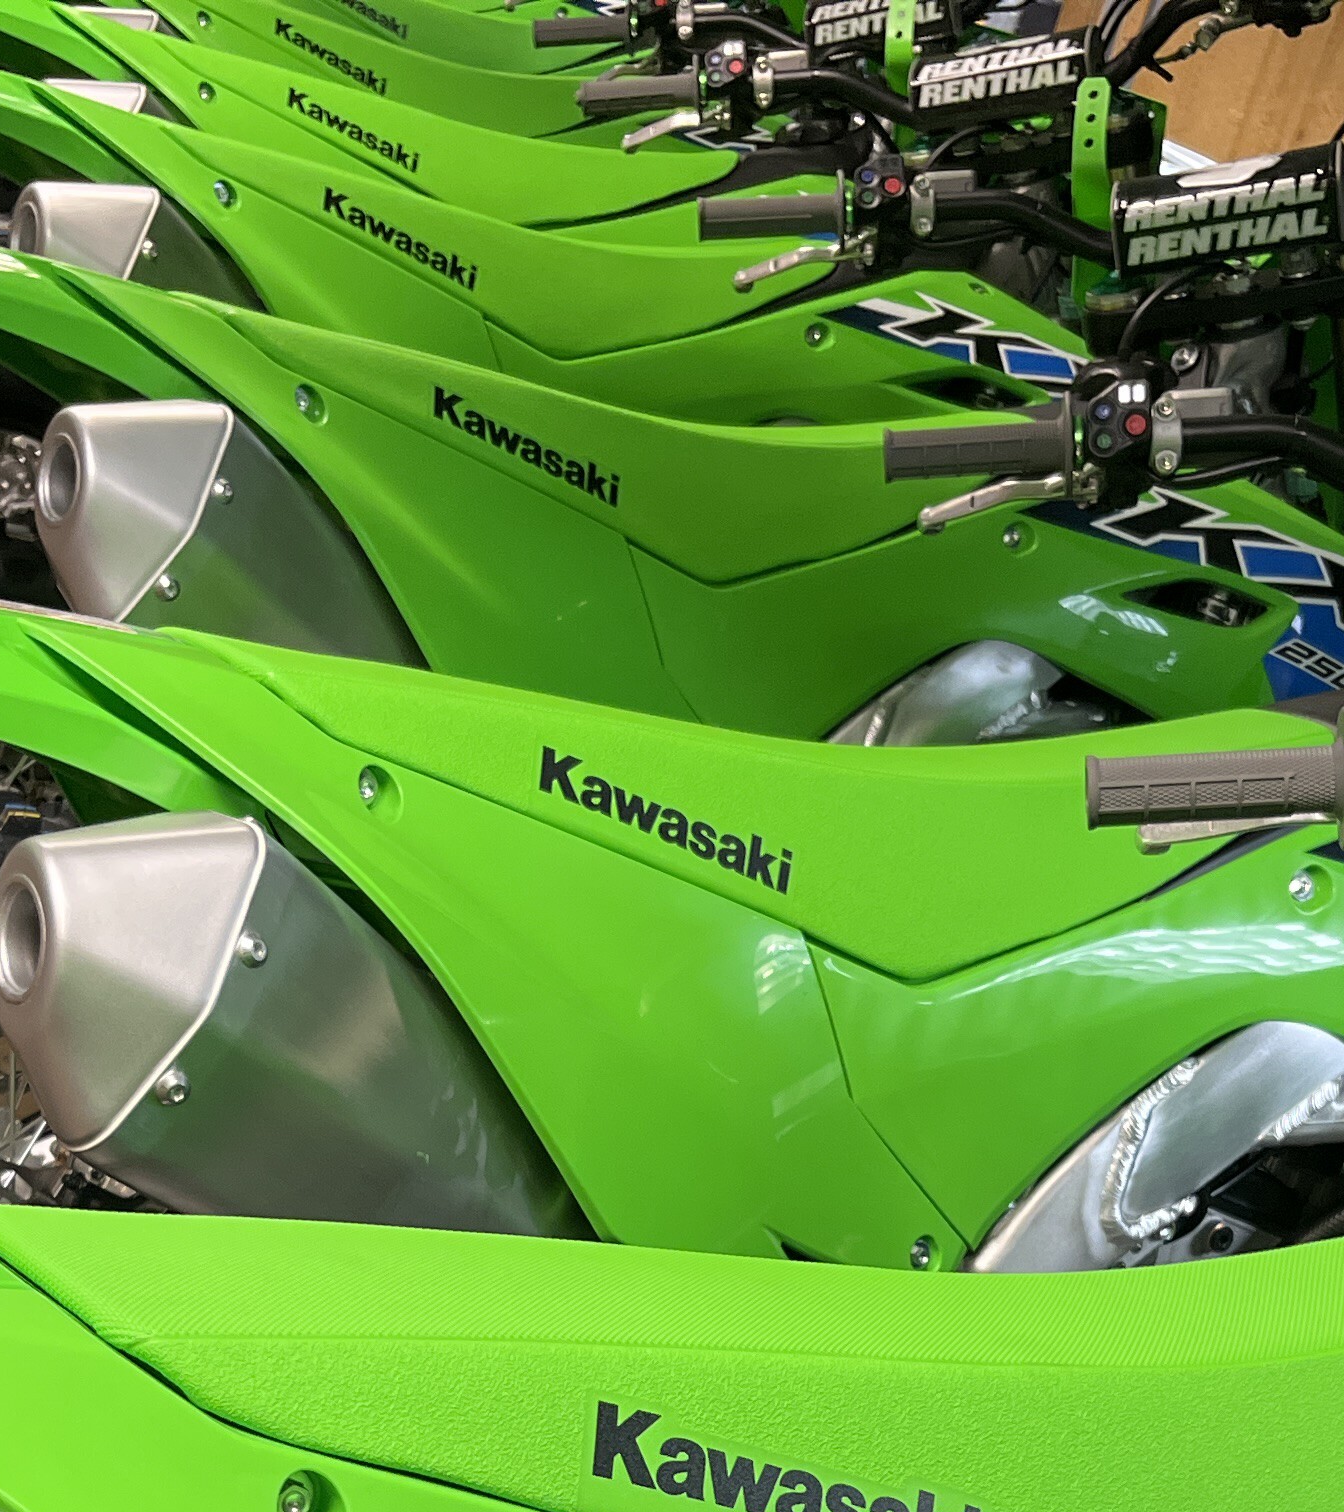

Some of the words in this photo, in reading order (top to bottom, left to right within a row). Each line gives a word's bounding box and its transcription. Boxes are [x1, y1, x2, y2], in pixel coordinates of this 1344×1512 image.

[275, 18, 387, 96] Kawasaki
[917, 38, 1079, 82] RENTHAL
[919, 59, 1077, 108] RENTHAL
[288, 87, 419, 173] Kawasaki
[323, 187, 479, 292] Kawasaki
[1124, 173, 1325, 232] RENTHAL
[1127, 208, 1328, 266] RENTHAL
[433, 385, 621, 509] Kawasaki
[539, 745, 793, 895] Kawasaki
